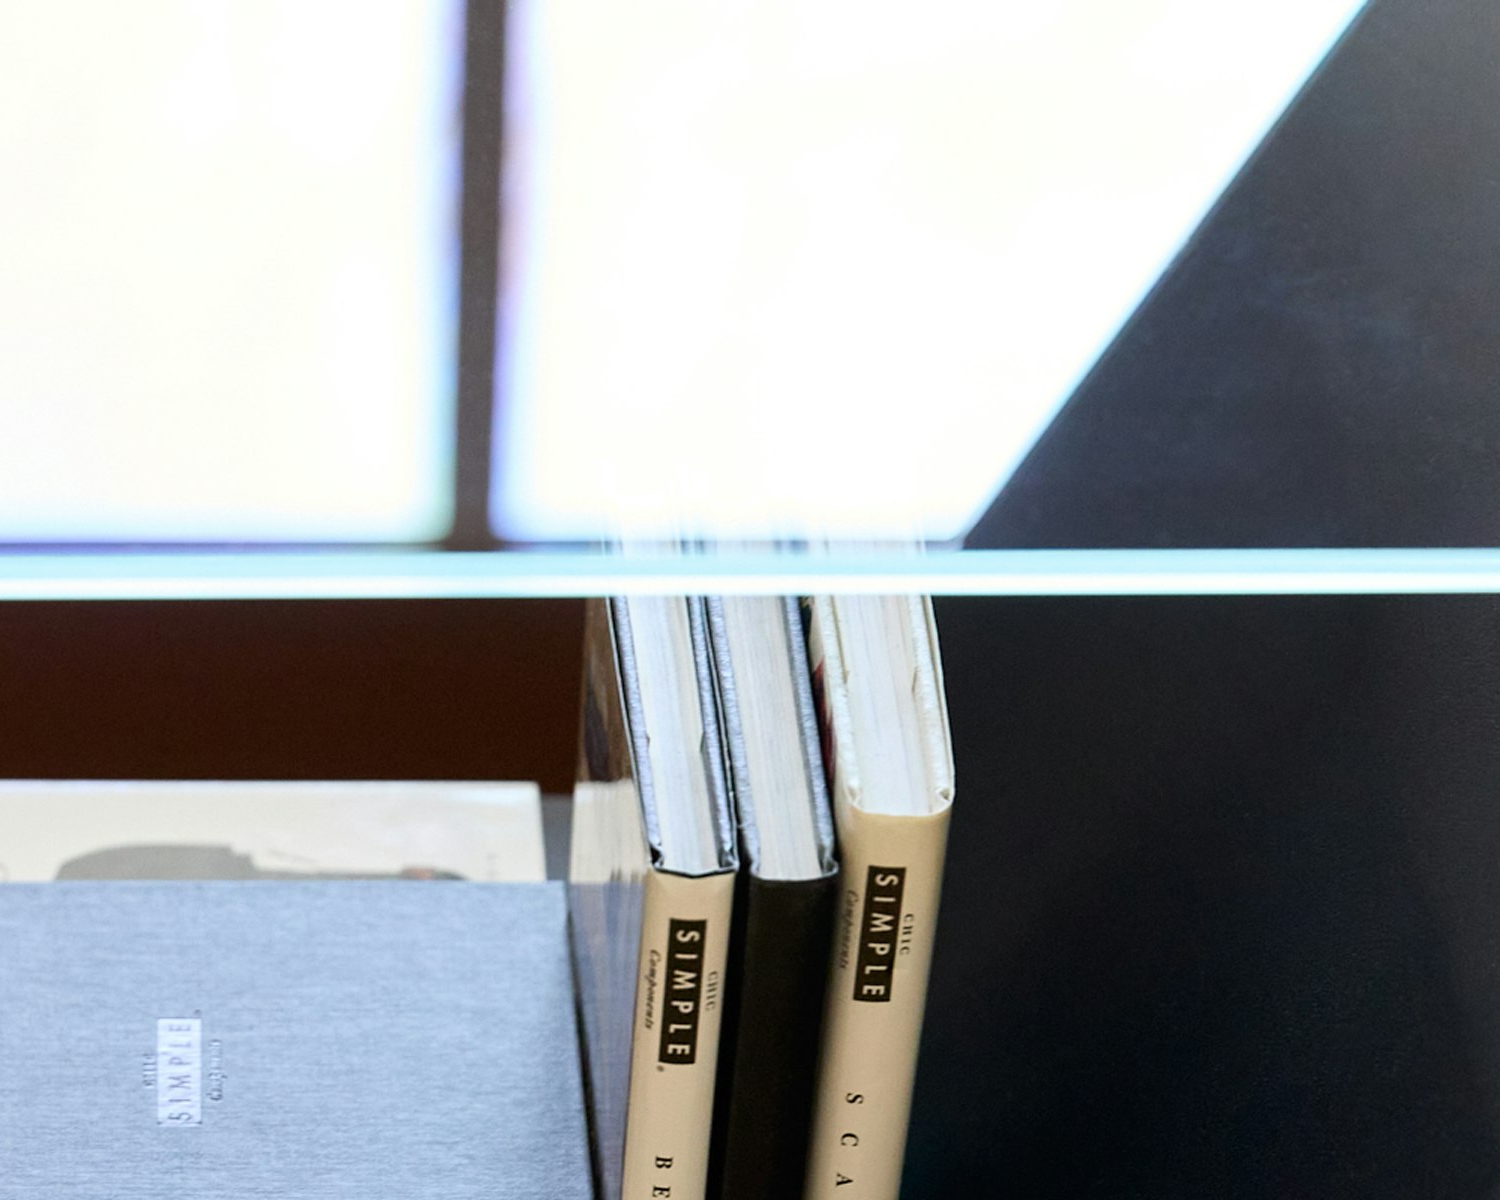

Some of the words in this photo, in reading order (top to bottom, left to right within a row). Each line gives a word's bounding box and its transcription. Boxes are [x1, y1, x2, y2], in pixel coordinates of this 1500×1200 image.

[861, 872, 899, 997] SIMPLE
[900, 913, 915, 956] CHIC
[643, 949, 661, 1030] Components
[667, 929, 701, 1056] SIMPLE
[705, 970, 719, 1011] CHIC
[167, 1023, 193, 1121] SIMPLE
